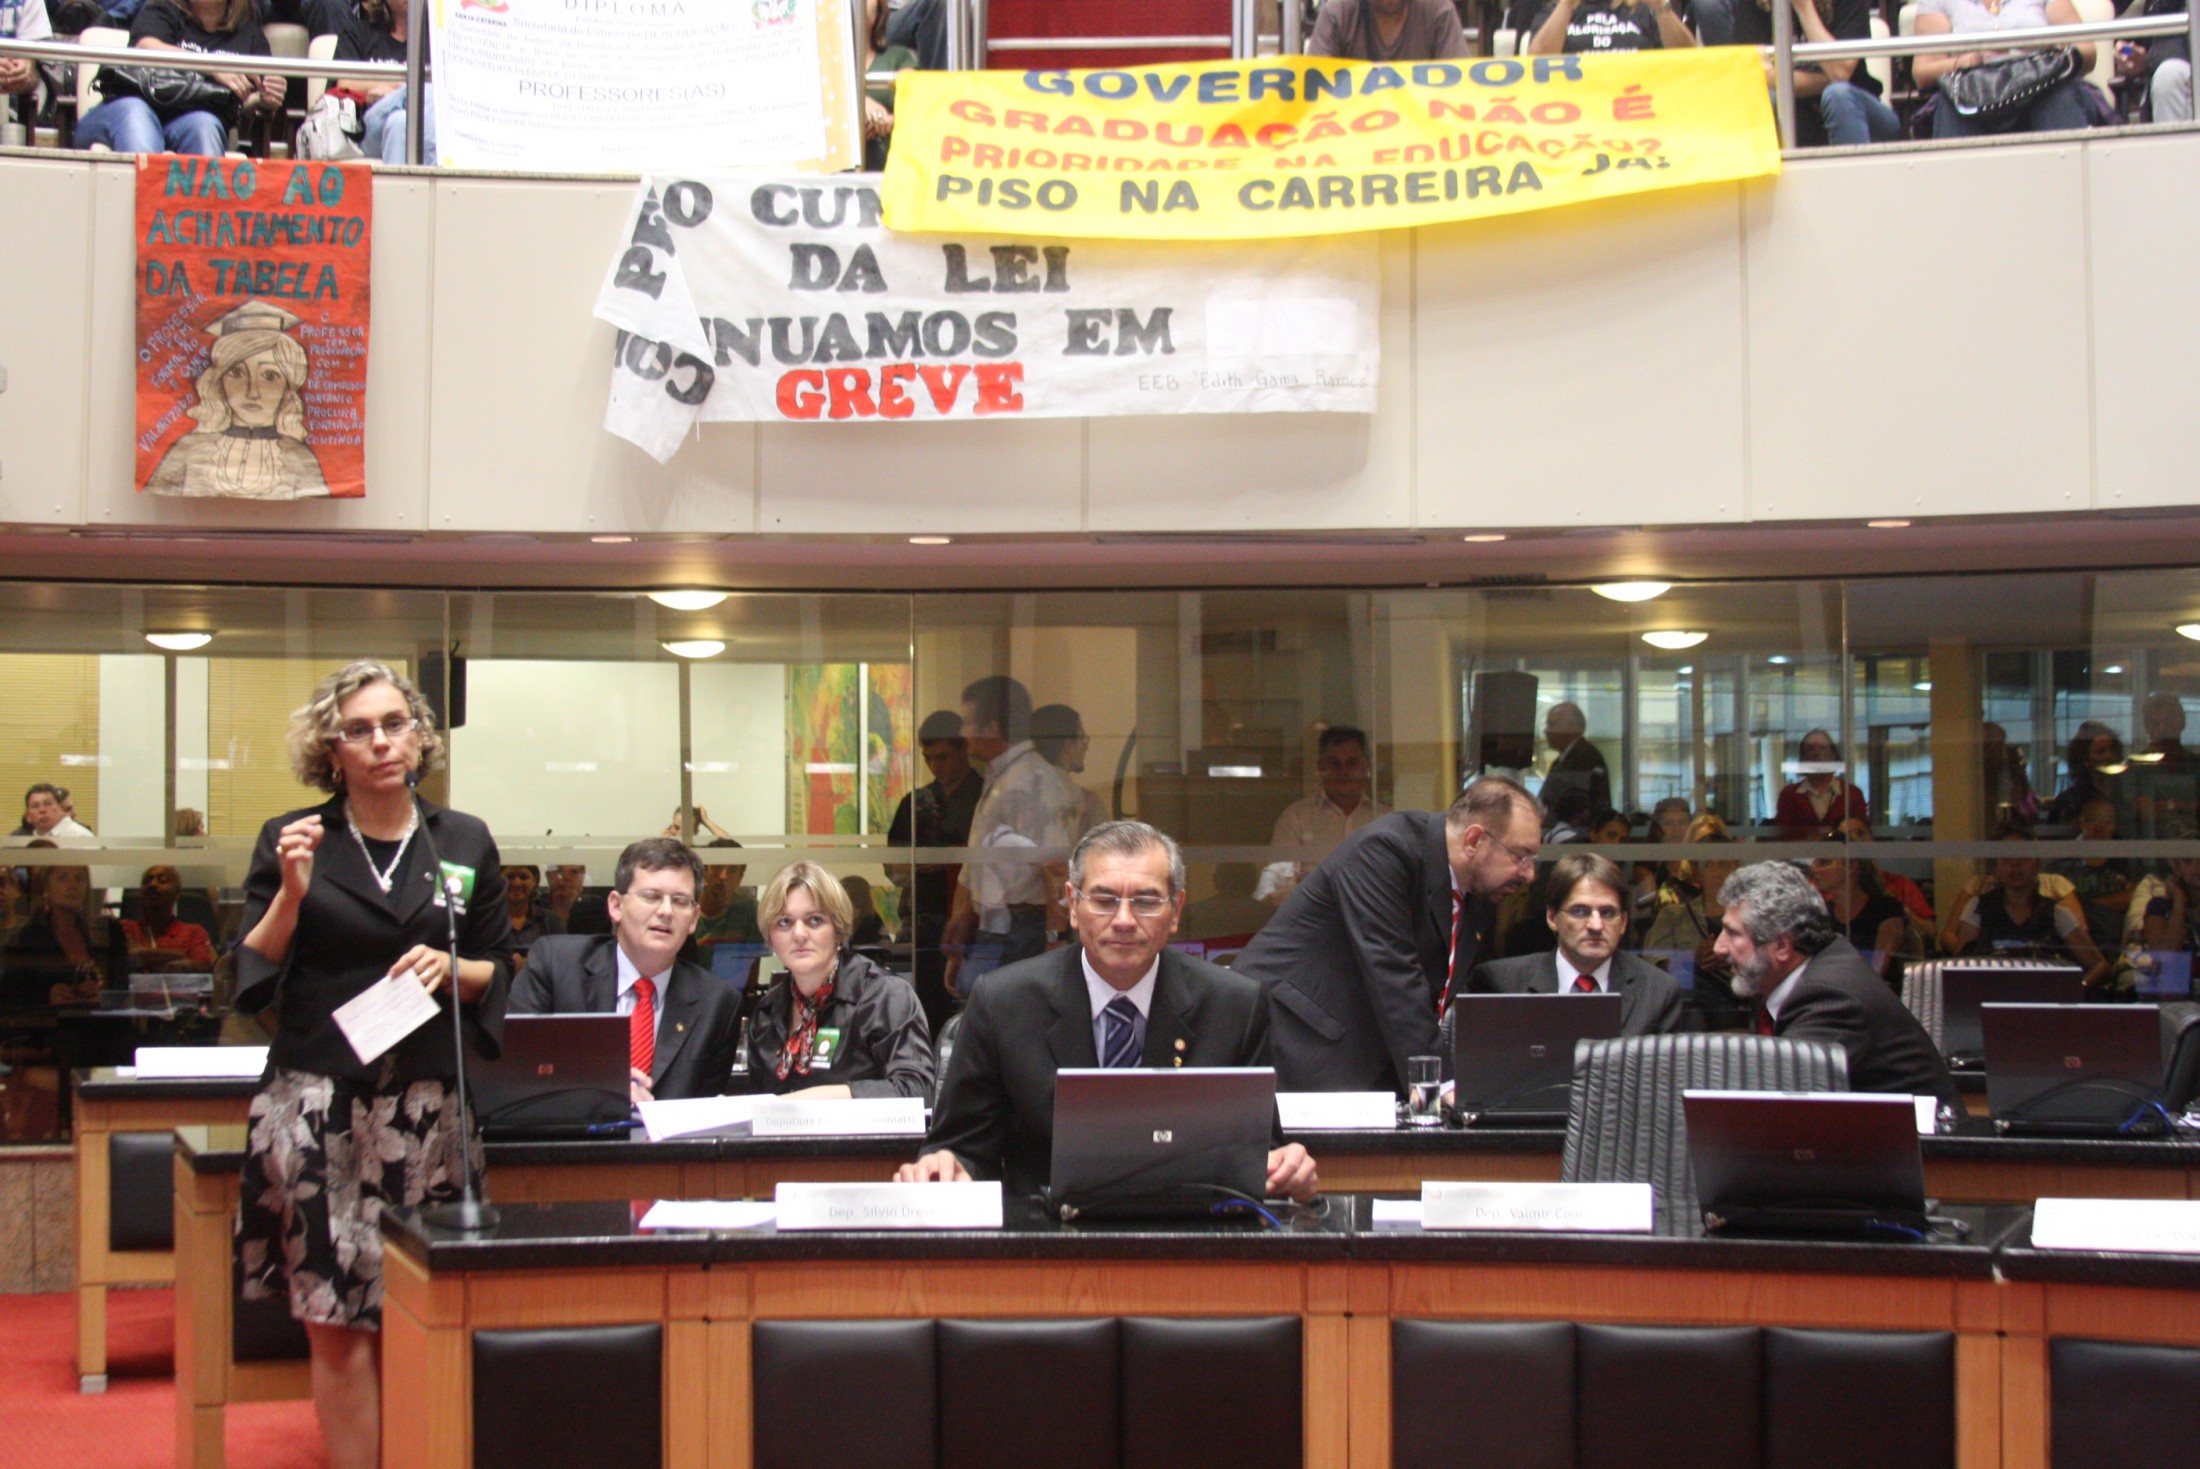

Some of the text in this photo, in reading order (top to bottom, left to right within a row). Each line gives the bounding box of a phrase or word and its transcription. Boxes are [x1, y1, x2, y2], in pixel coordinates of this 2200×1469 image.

[513, 16, 567, 33] Secretaria
[565, 0, 686, 16] DIPLOMA
[1593, 35, 1612, 48] DO
[448, 51, 513, 75] LICENCIATURA
[1023, 55, 1583, 104] GOVERNADOR
[519, 79, 726, 103] PROFESSORES(AS)
[948, 84, 1656, 152] GRADUAÇÃO NÃO É
[940, 135, 1242, 172] PRIORIDADE
[1273, 153, 1338, 170] NA
[282, 164, 345, 207] AO
[936, 174, 1079, 211] PISO
[1119, 178, 1200, 214] NA
[1237, 161, 1543, 211] CARREIRA
[146, 208, 364, 248] ACHATAMENTO
[146, 259, 339, 300] DA TABELA
[788, 243, 1070, 294] DA LEI
[140, 292, 208, 362] O PROFESSOR
[1062, 307, 1176, 356] EM
[776, 360, 1024, 420] GREVE
[1138, 374, 1180, 392] EEB
[140, 392, 193, 453] VALORIZADO
[829, 1205, 858, 1219] Dep.
[863, 1205, 897, 1217] Silvio
[1475, 1207, 1504, 1221] Dep.
[1509, 1207, 1551, 1219] Valmir
